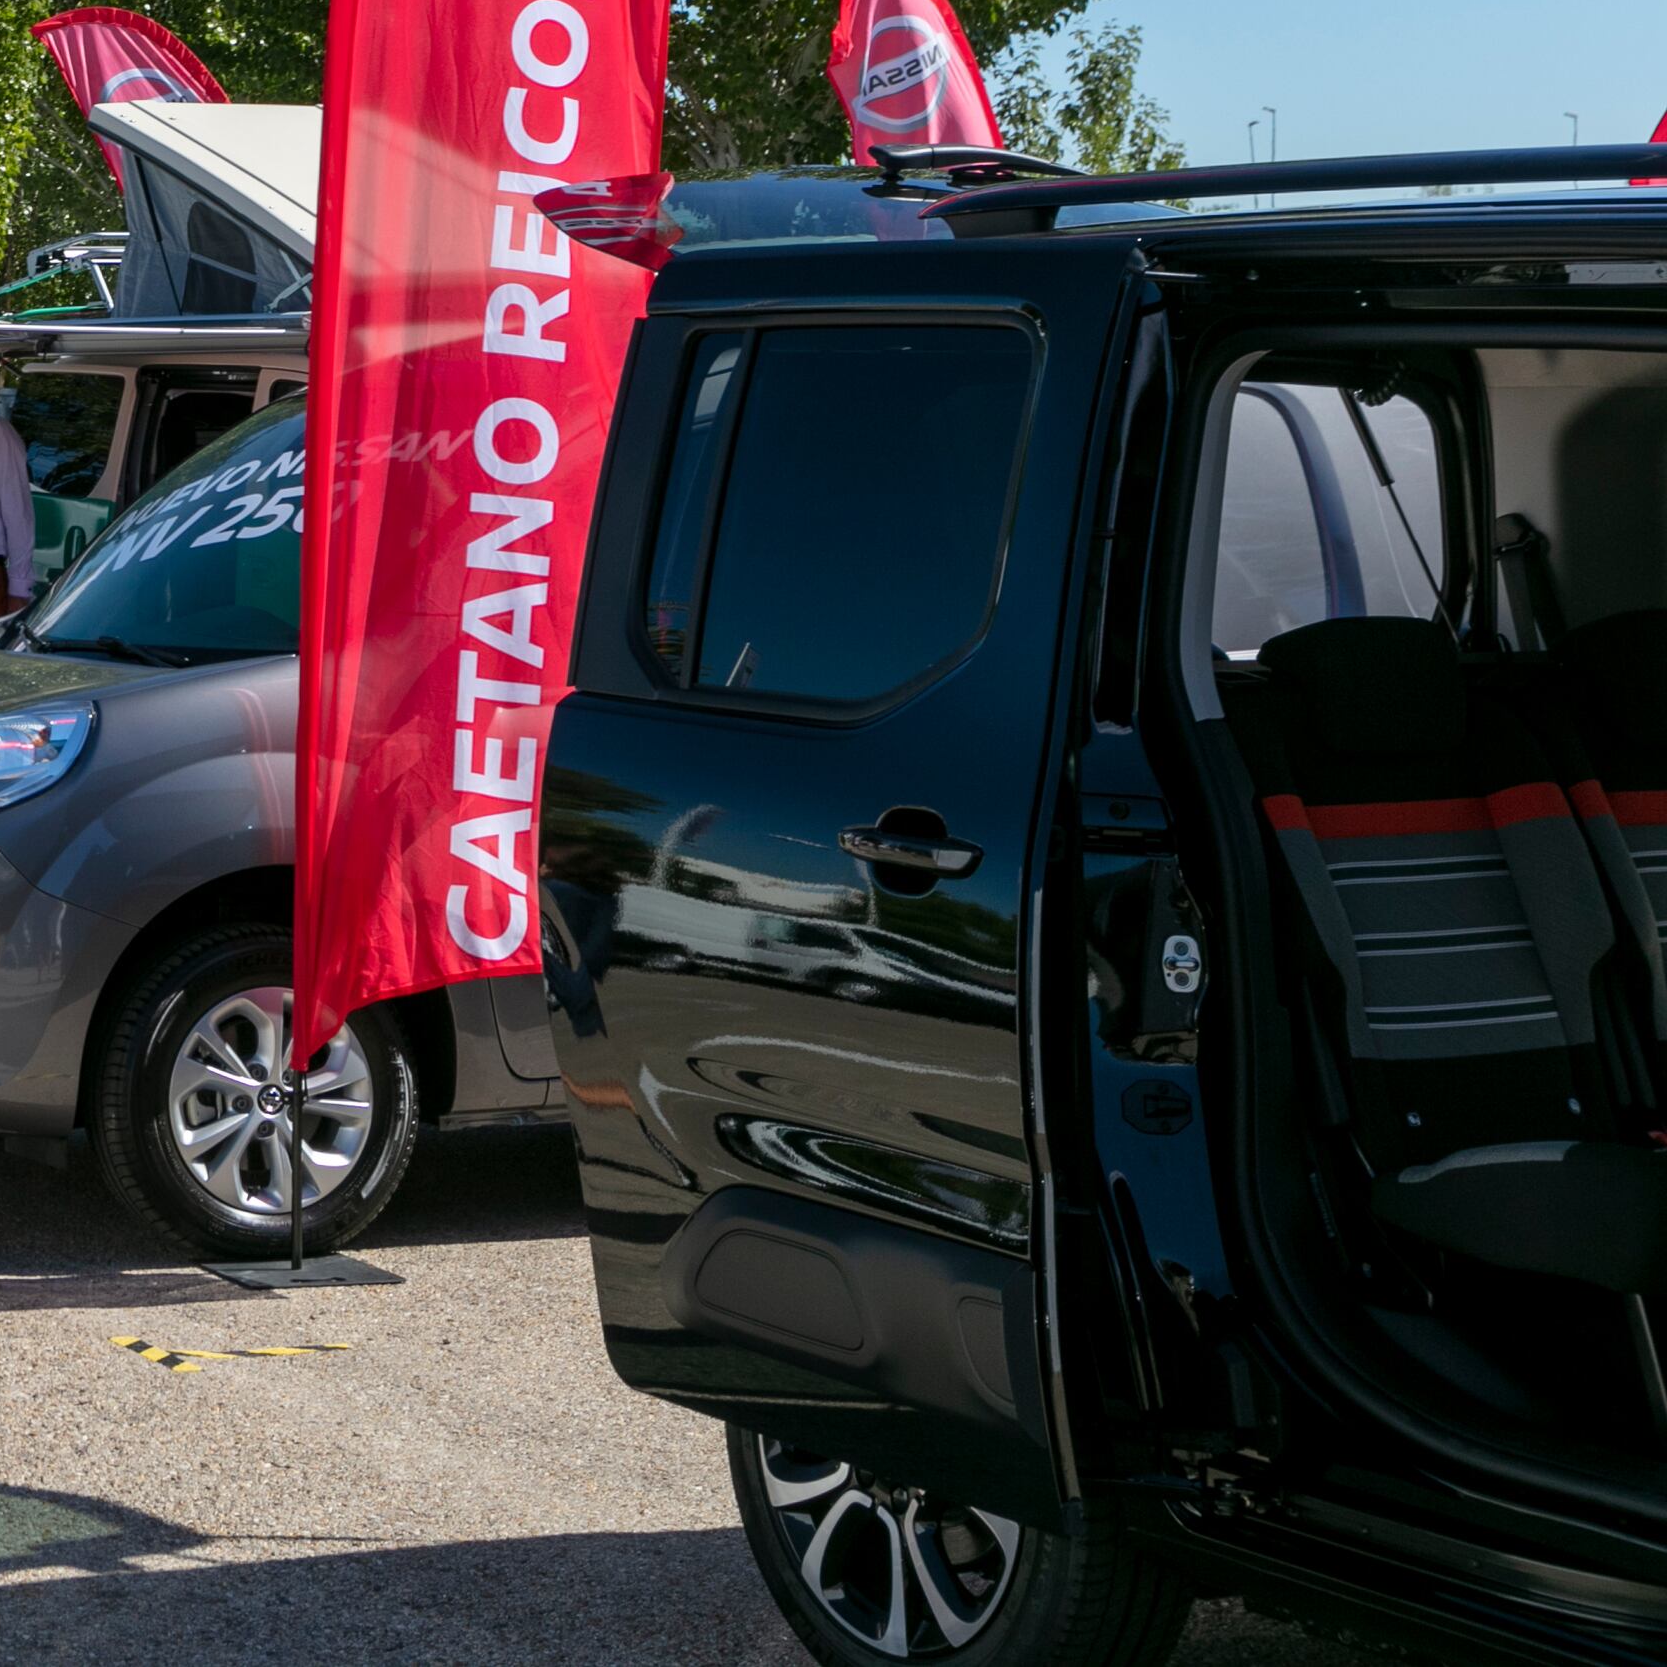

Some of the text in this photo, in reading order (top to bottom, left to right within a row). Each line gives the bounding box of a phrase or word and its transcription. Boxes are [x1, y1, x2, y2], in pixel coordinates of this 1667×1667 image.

[107, 460, 262, 542] NUEVO
[109, 504, 213, 572] NV
[446, 396, 560, 962] CAETANO
